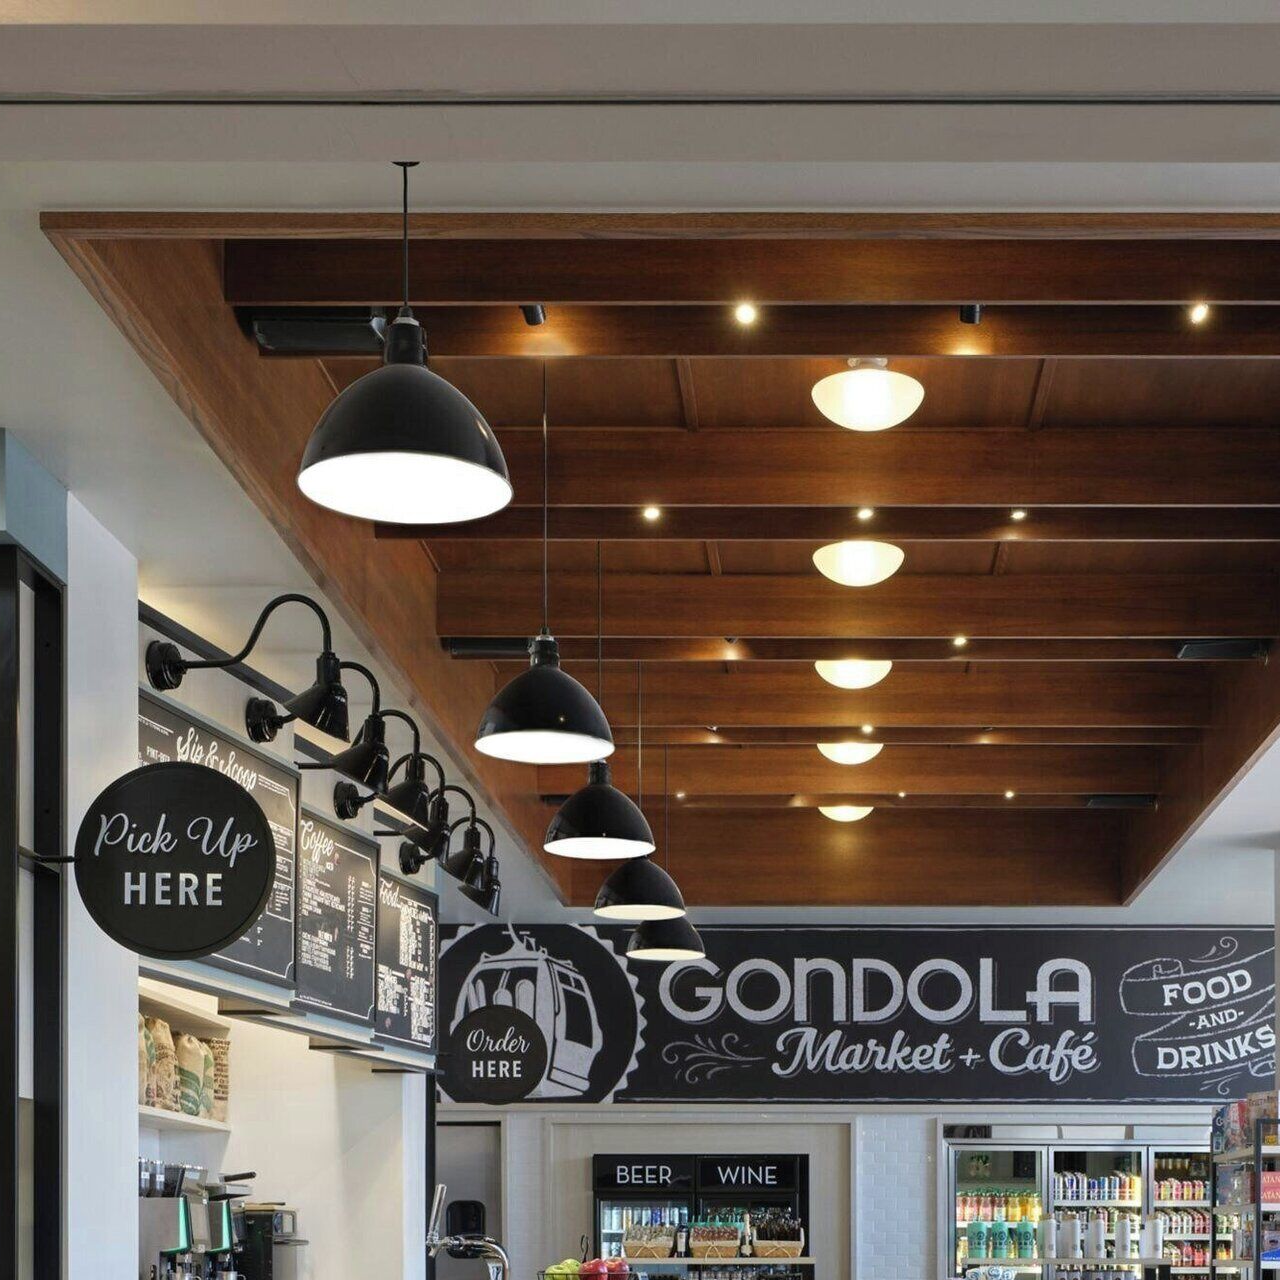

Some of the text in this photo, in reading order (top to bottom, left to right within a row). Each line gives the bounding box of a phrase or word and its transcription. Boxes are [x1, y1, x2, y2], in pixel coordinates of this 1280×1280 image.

[94, 813, 177, 856] Pick
[187, 816, 258, 868] Up
[300, 819, 334, 862] Coffee
[123, 872, 222, 906] HERE
[380, 877, 400, 908] Food
[659, 957, 1094, 1024] GONDOLA
[1162, 968, 1252, 1006] FOOD
[466, 1026, 531, 1054] Order
[772, 1027, 952, 1076] Market
[989, 1028, 1098, 1083] Café
[1157, 1024, 1275, 1070] DRINKS
[472, 1060, 522, 1078] HERE
[616, 1165, 672, 1184] BEER
[718, 1165, 778, 1185] WINE
